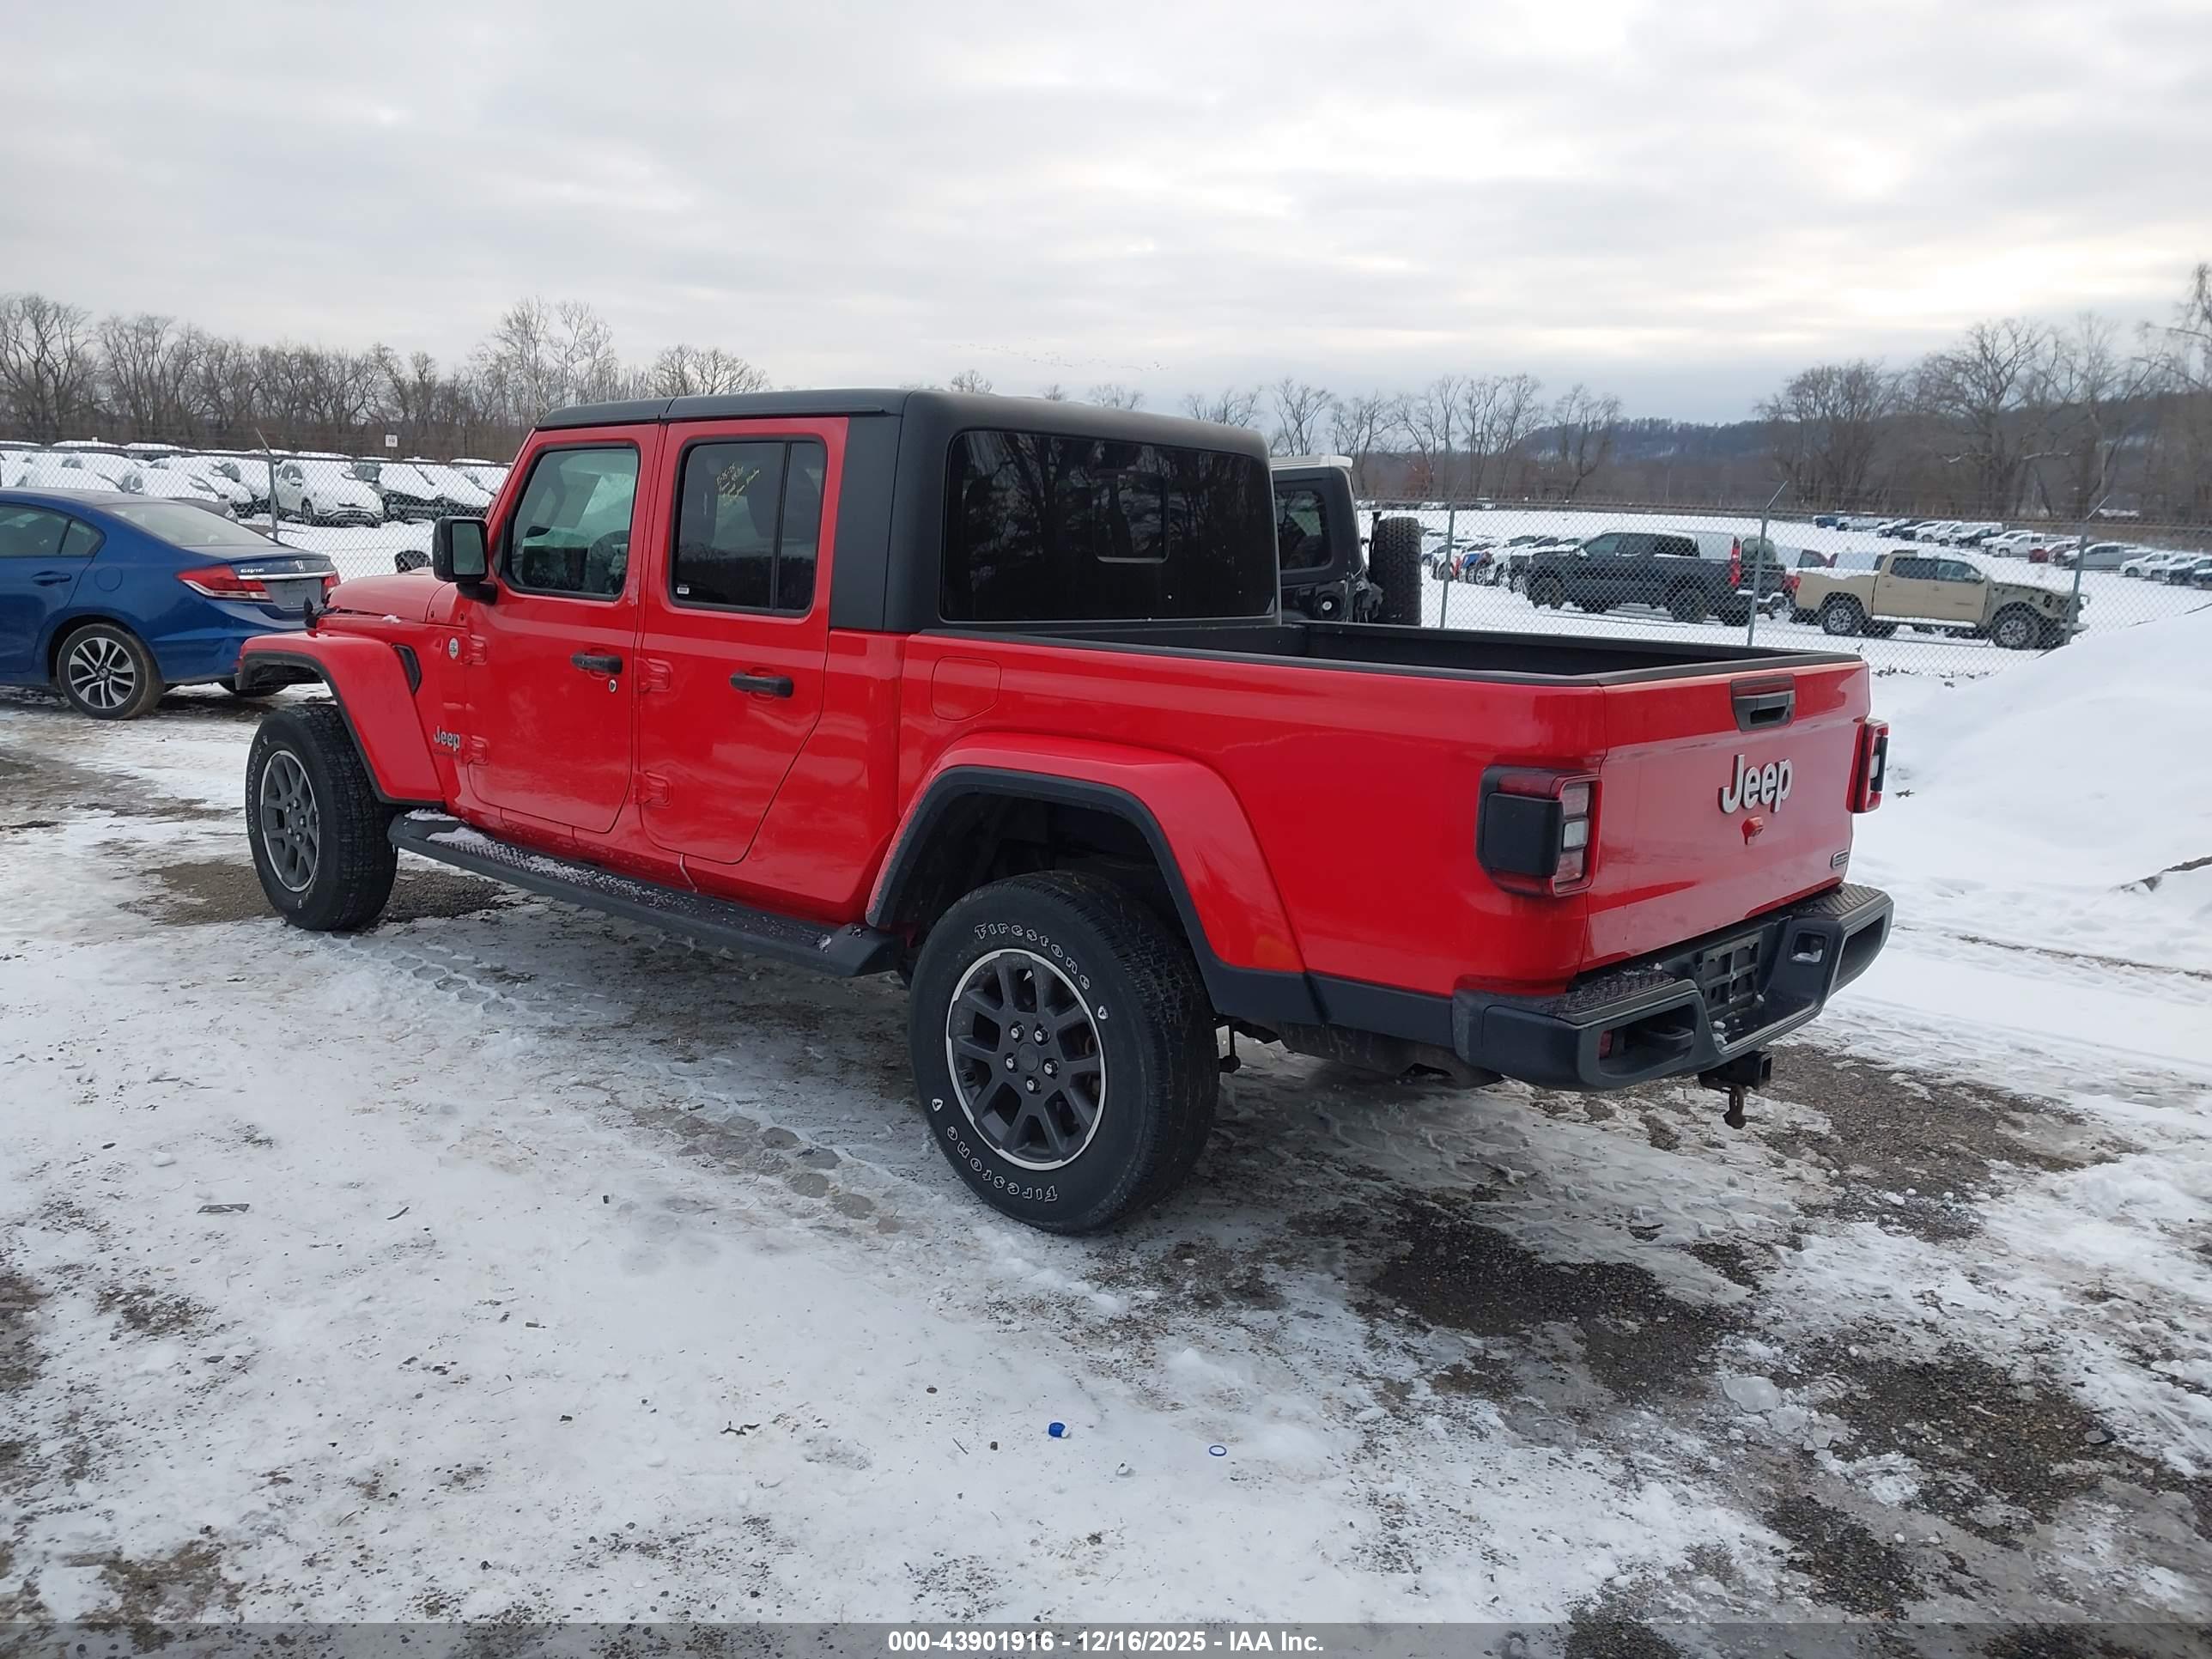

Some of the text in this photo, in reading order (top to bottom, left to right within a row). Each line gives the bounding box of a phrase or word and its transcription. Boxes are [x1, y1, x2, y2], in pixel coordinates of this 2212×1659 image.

[434, 726, 460, 751] Jeep
[1719, 754, 1793, 814] Jeep
[975, 921, 1091, 990] Firestone
[946, 1125, 1058, 1203] Firestone
